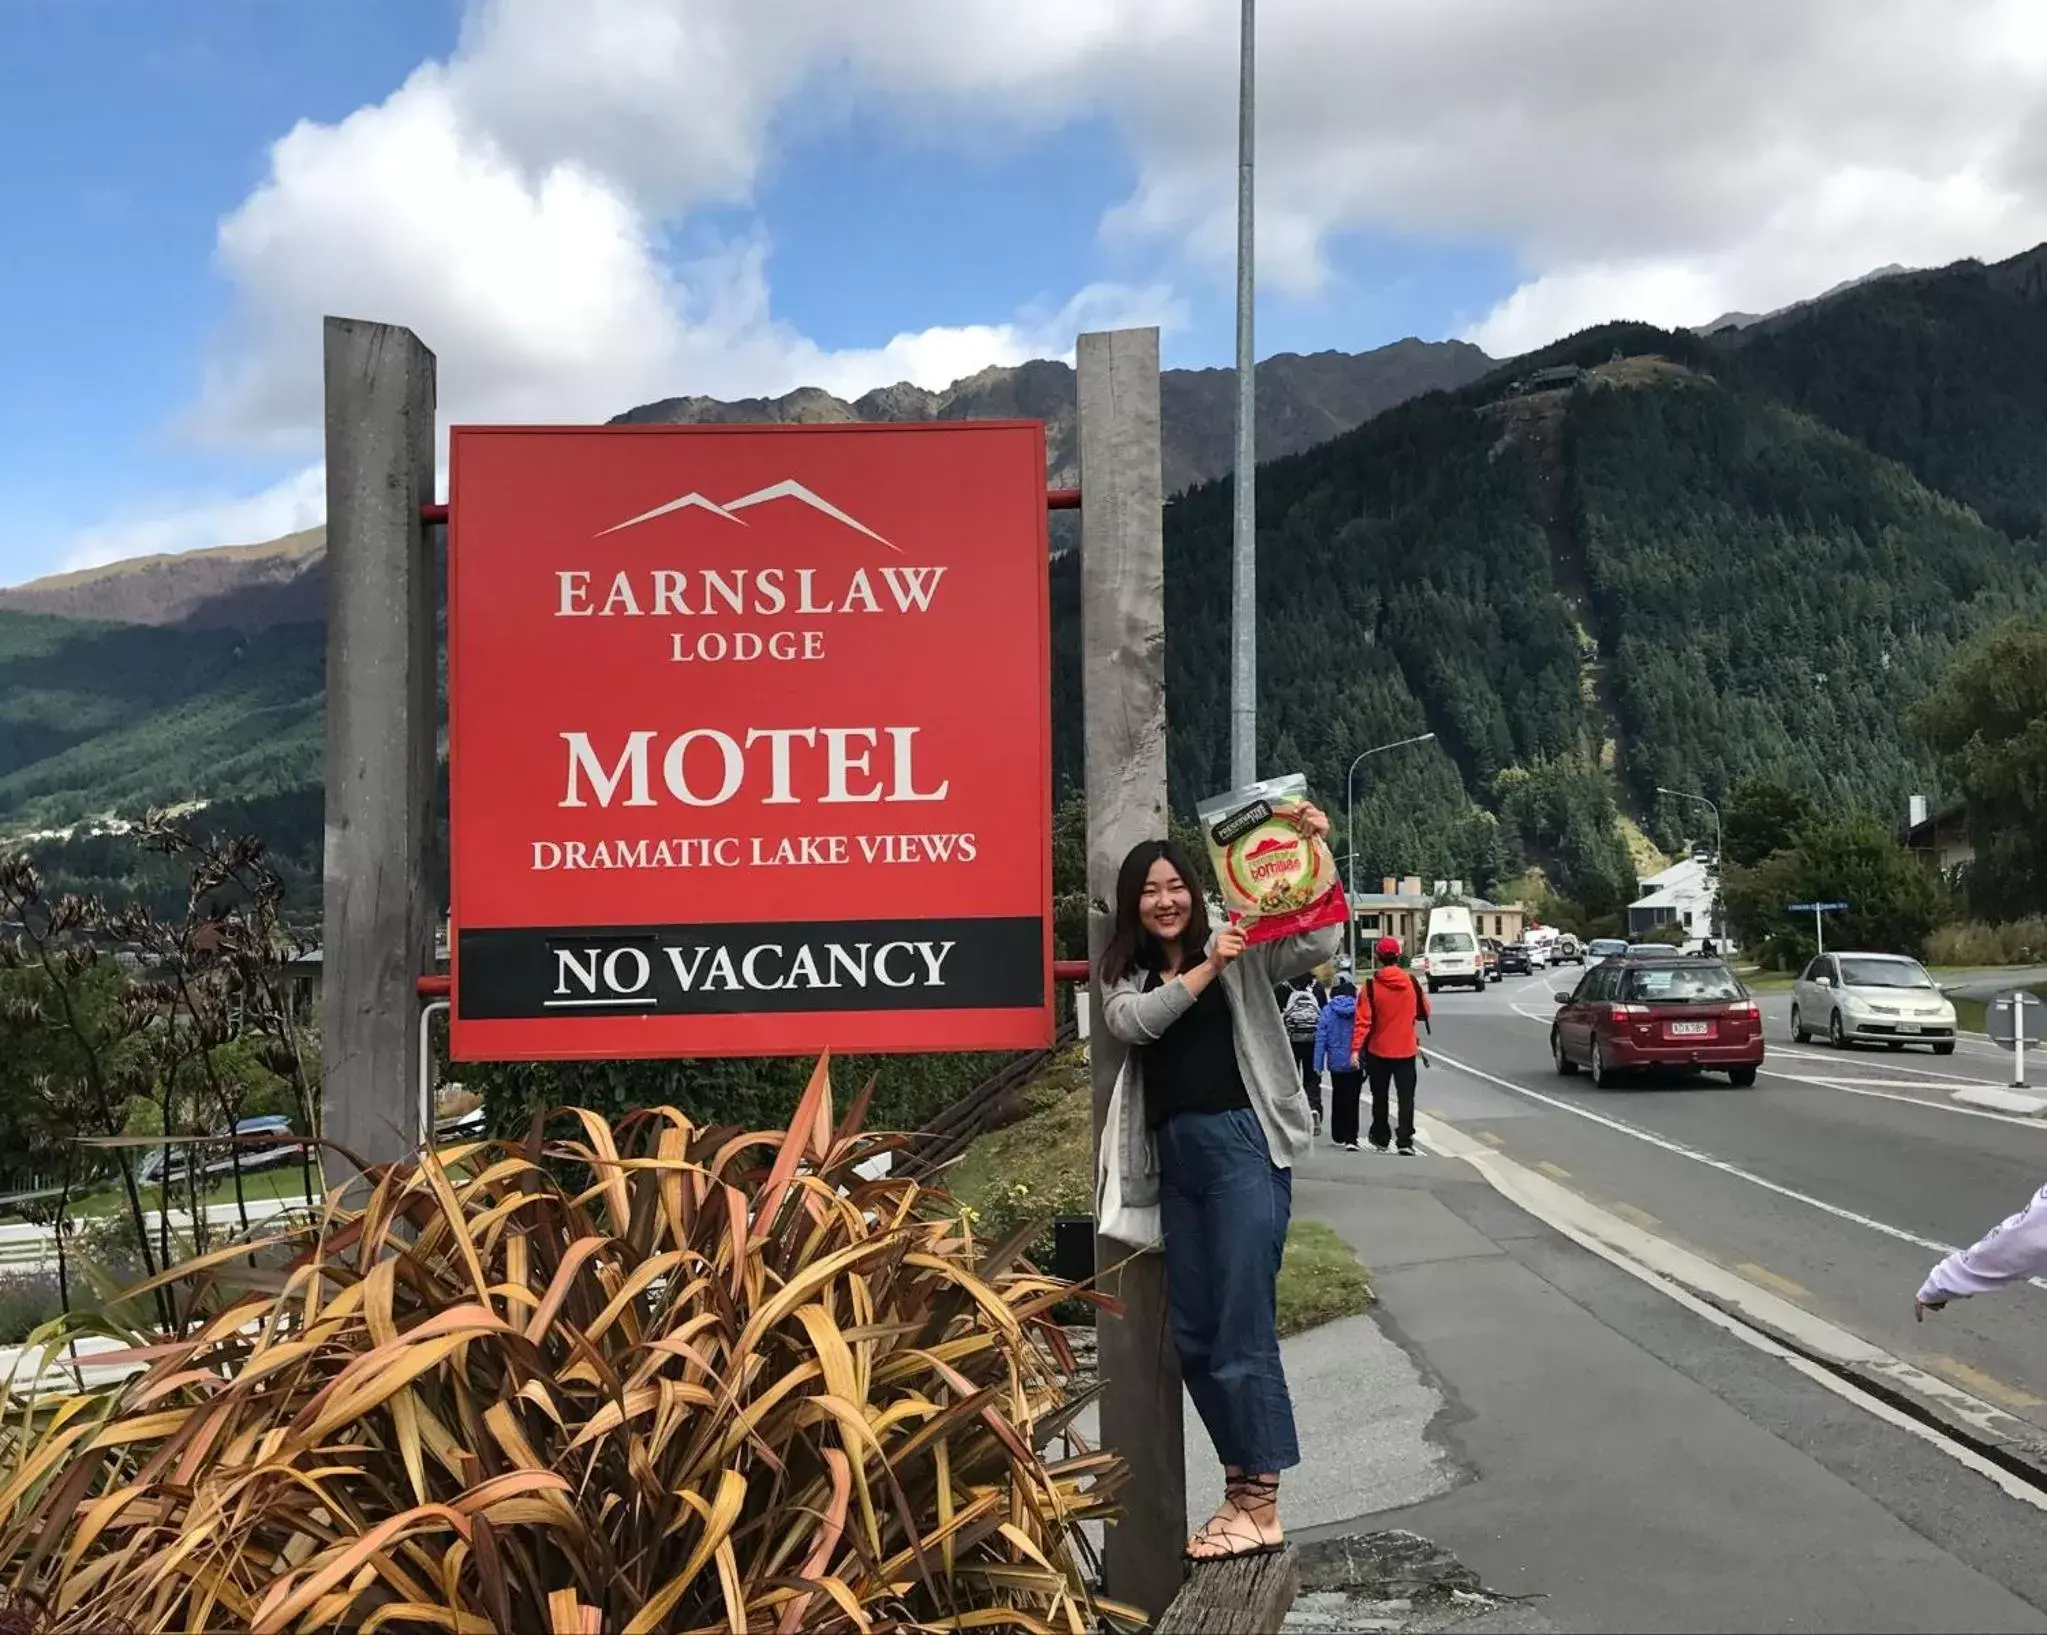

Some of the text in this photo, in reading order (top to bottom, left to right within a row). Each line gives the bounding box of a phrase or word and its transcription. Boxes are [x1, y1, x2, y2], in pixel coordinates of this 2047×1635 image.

[554, 566, 948, 617] EARNSLAW
[671, 631, 825, 662] LODGE
[558, 726, 949, 808] MOTEL
[531, 833, 977, 870] DRAMATIC LAKE VIEWS
[553, 941, 956, 994] NO VACANCY
